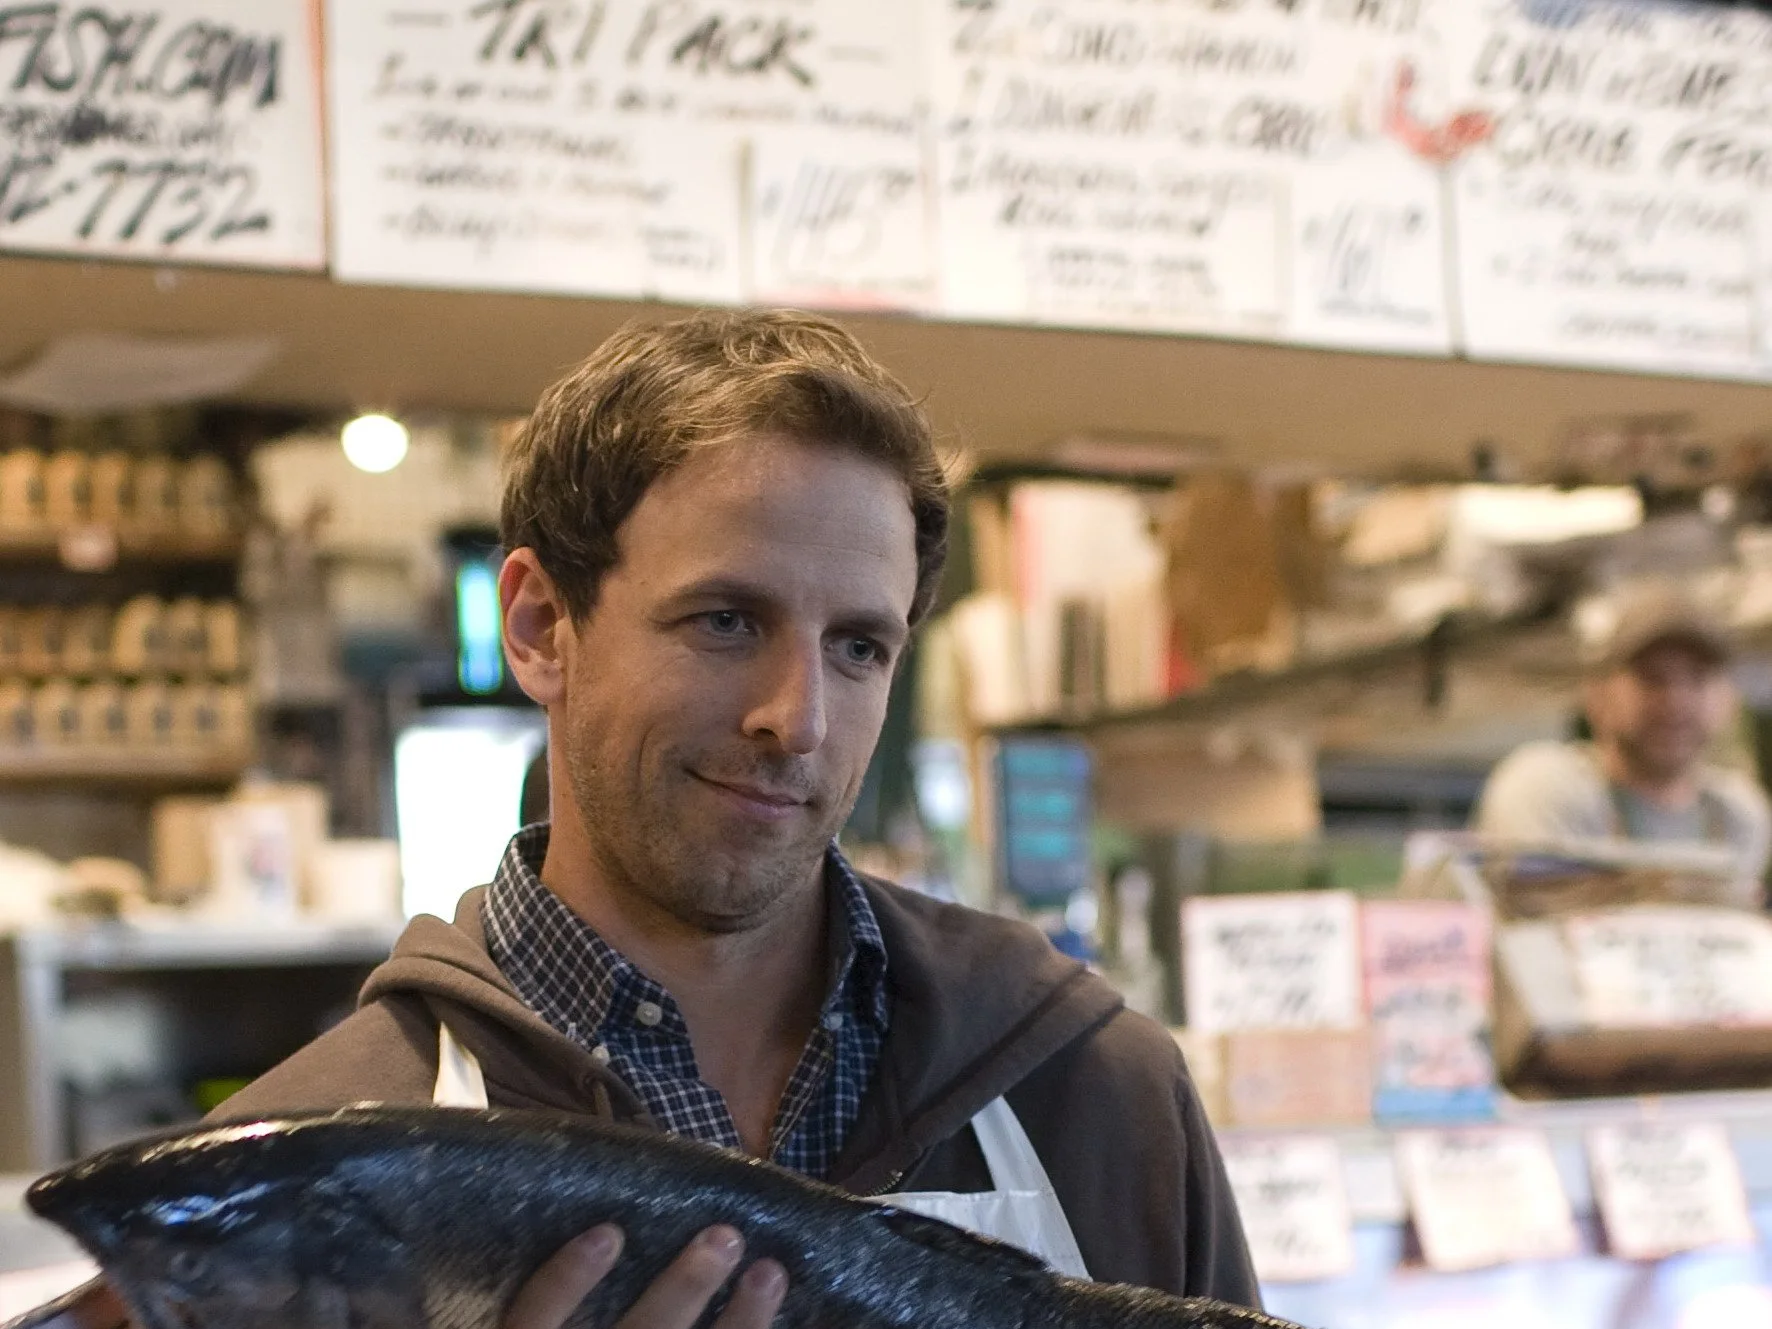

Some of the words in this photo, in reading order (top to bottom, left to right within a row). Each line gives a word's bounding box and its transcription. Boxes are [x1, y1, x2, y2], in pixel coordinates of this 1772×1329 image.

[471, 0, 606, 70] TRI
[626, 0, 818, 88] PACK
[0, 152, 272, 246] 2-7732
